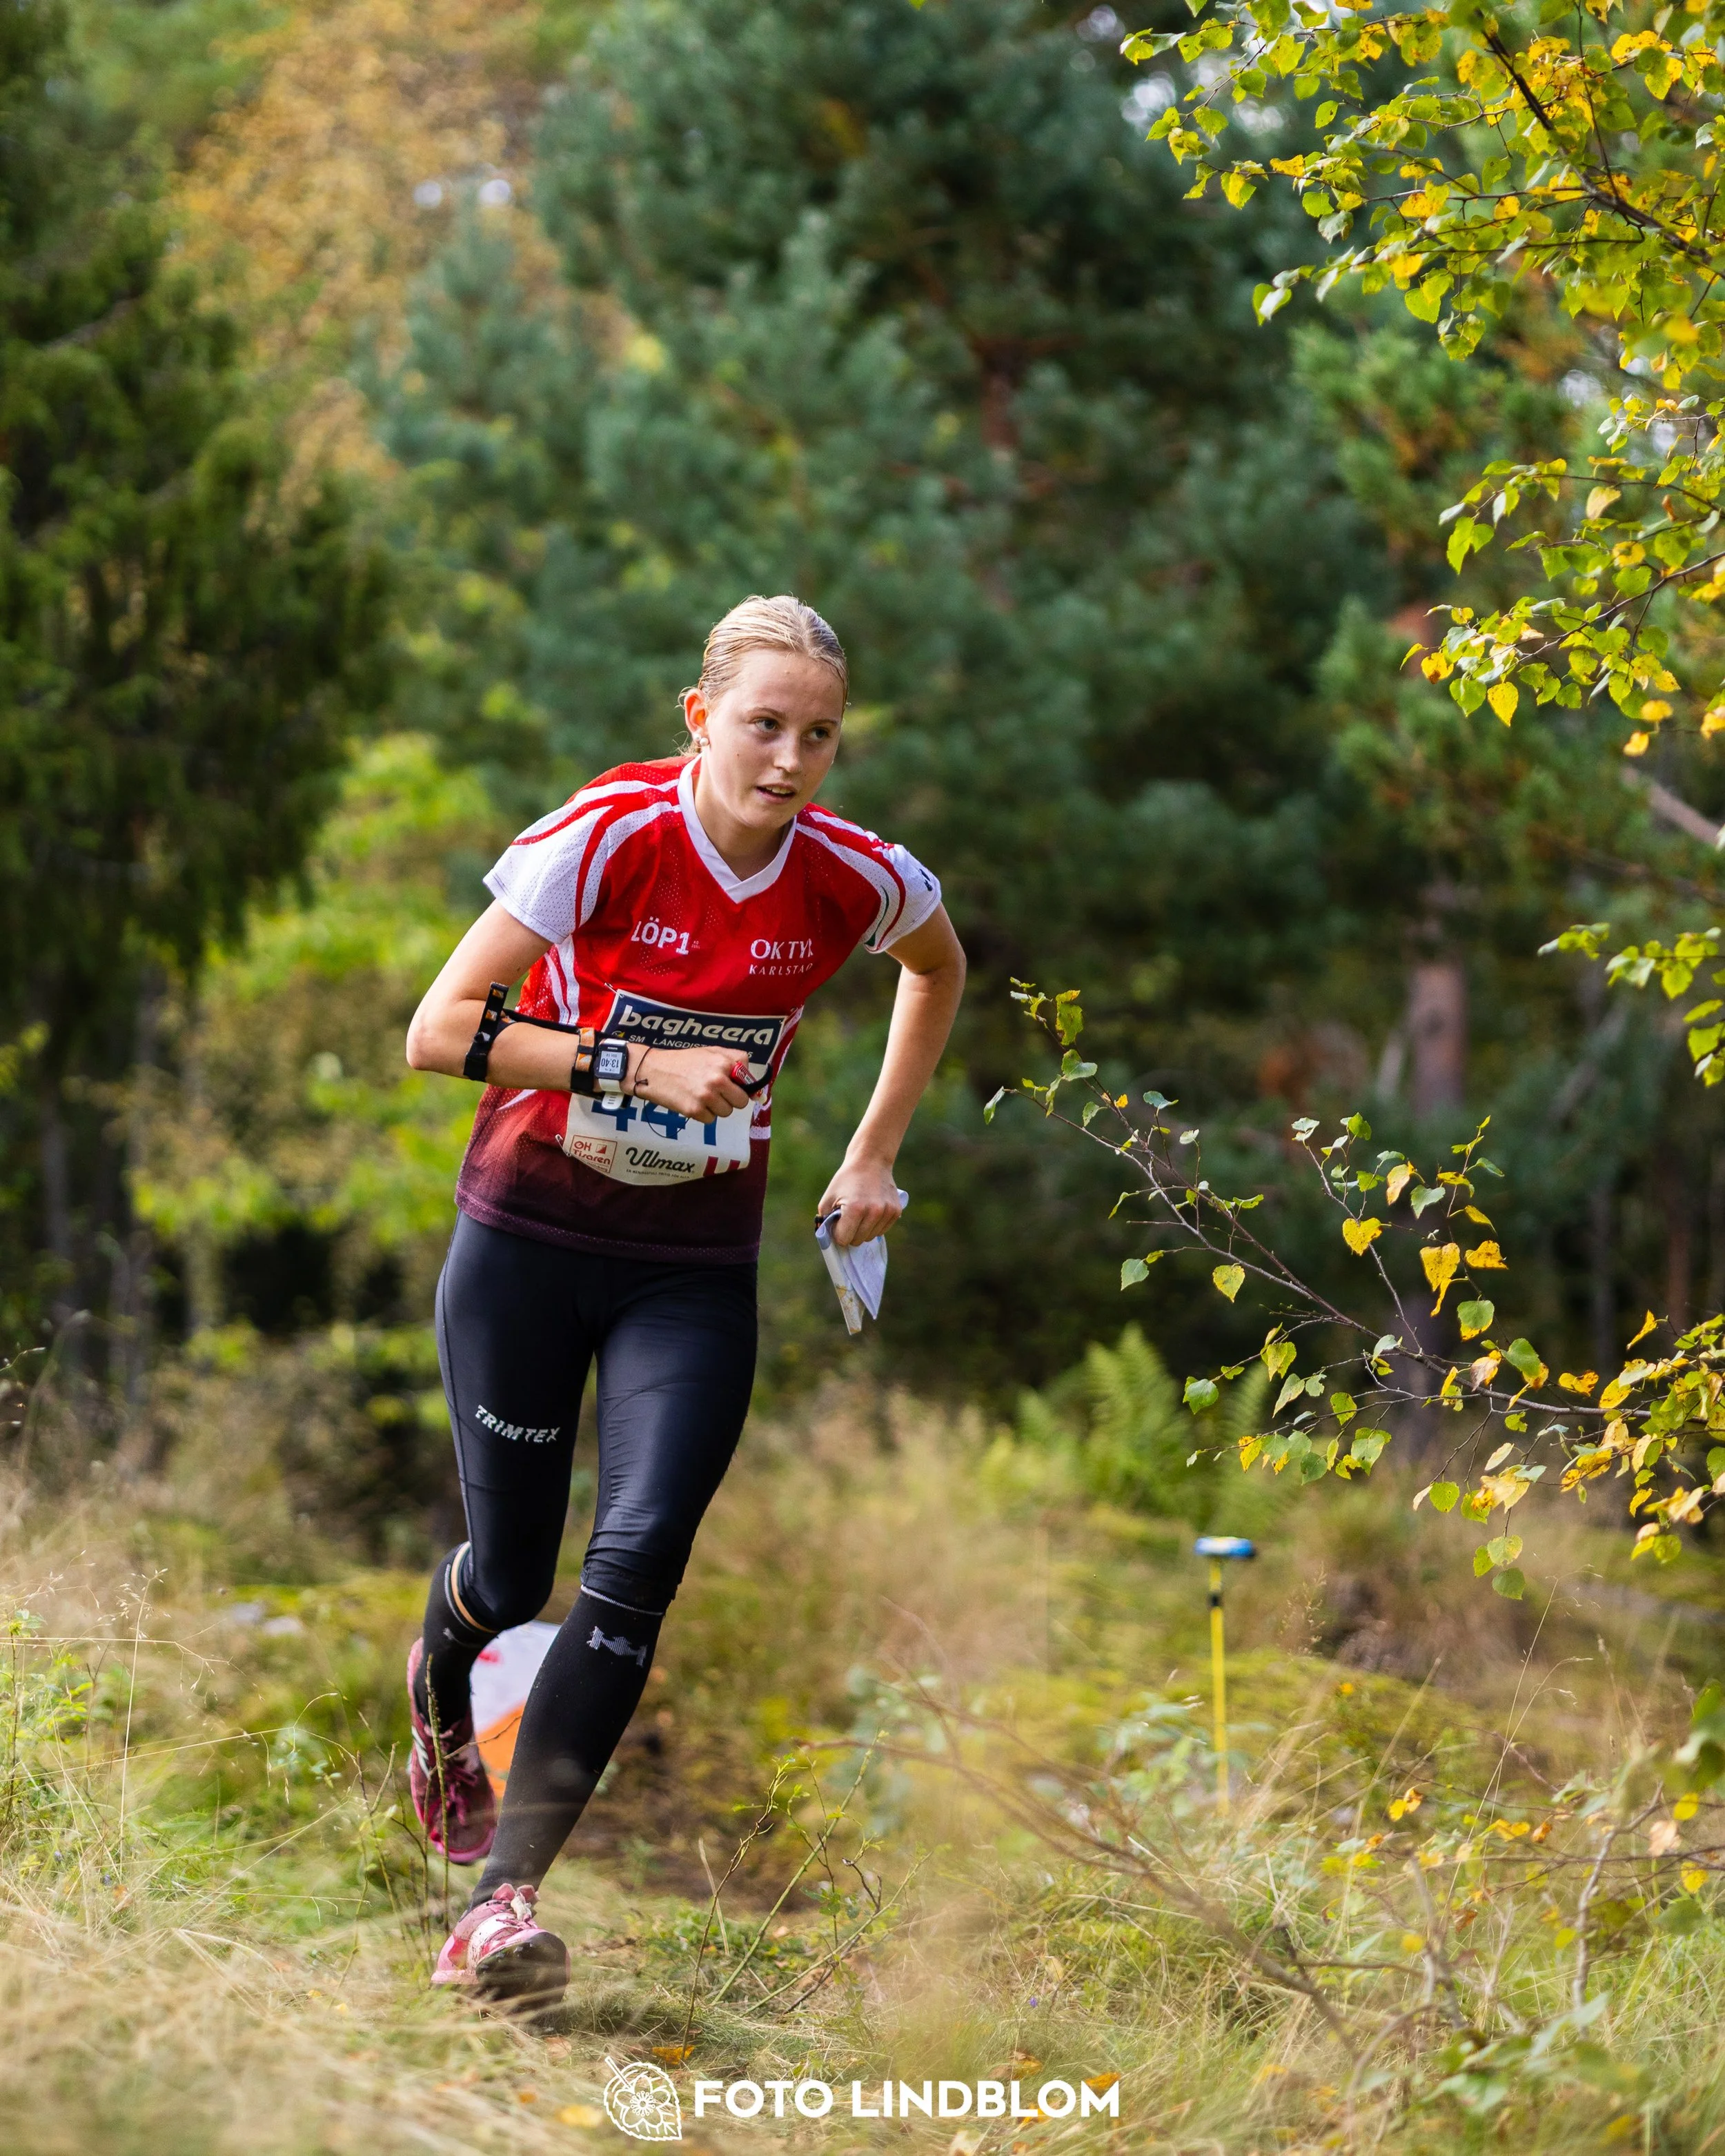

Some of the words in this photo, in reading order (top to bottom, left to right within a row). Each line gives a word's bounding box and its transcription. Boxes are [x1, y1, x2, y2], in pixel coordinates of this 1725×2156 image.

[631, 916, 689, 955] LÖP1
[750, 938, 785, 960] OK
[749, 963, 814, 976] KARLSTAD
[618, 1005, 774, 1046] bagheera
[629, 1034, 646, 1043] SM
[573, 1148, 611, 1165] Tisaren
[625, 1147, 696, 1173] Ullmax
[475, 1404, 561, 1443] TRIMTEX
